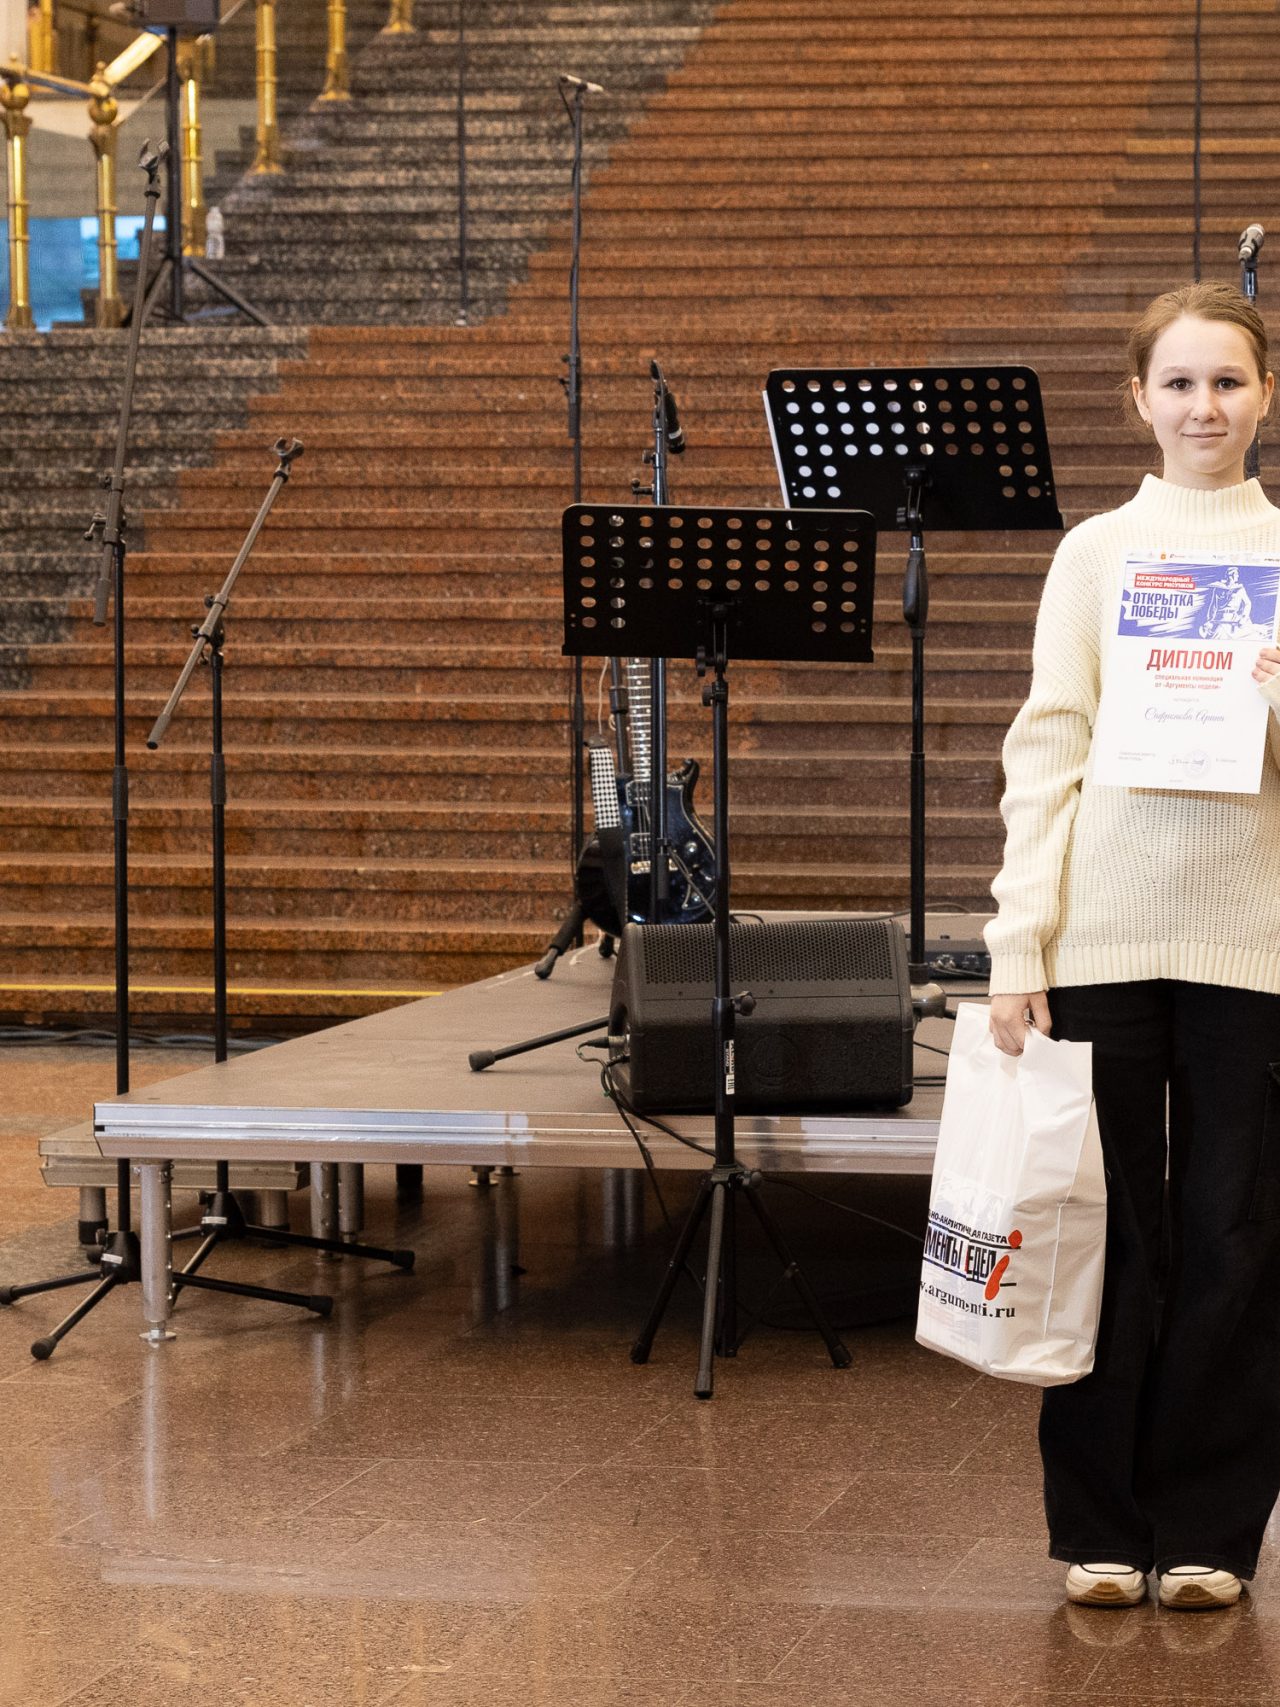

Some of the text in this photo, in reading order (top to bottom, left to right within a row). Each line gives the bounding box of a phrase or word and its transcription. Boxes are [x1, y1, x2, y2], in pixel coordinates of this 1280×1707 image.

[1136, 580, 1163, 588] КОНКУРС
[1137, 575, 1190, 583] МЕЖДУНАРОДНЫЙ
[1133, 592, 1194, 607] ОТКРЫТКА
[1131, 605, 1178, 620] ПОБЕДЫ
[1146, 648, 1233, 671] ДИПЛОМ
[981, 1231, 1008, 1244] ГАЗЕТА
